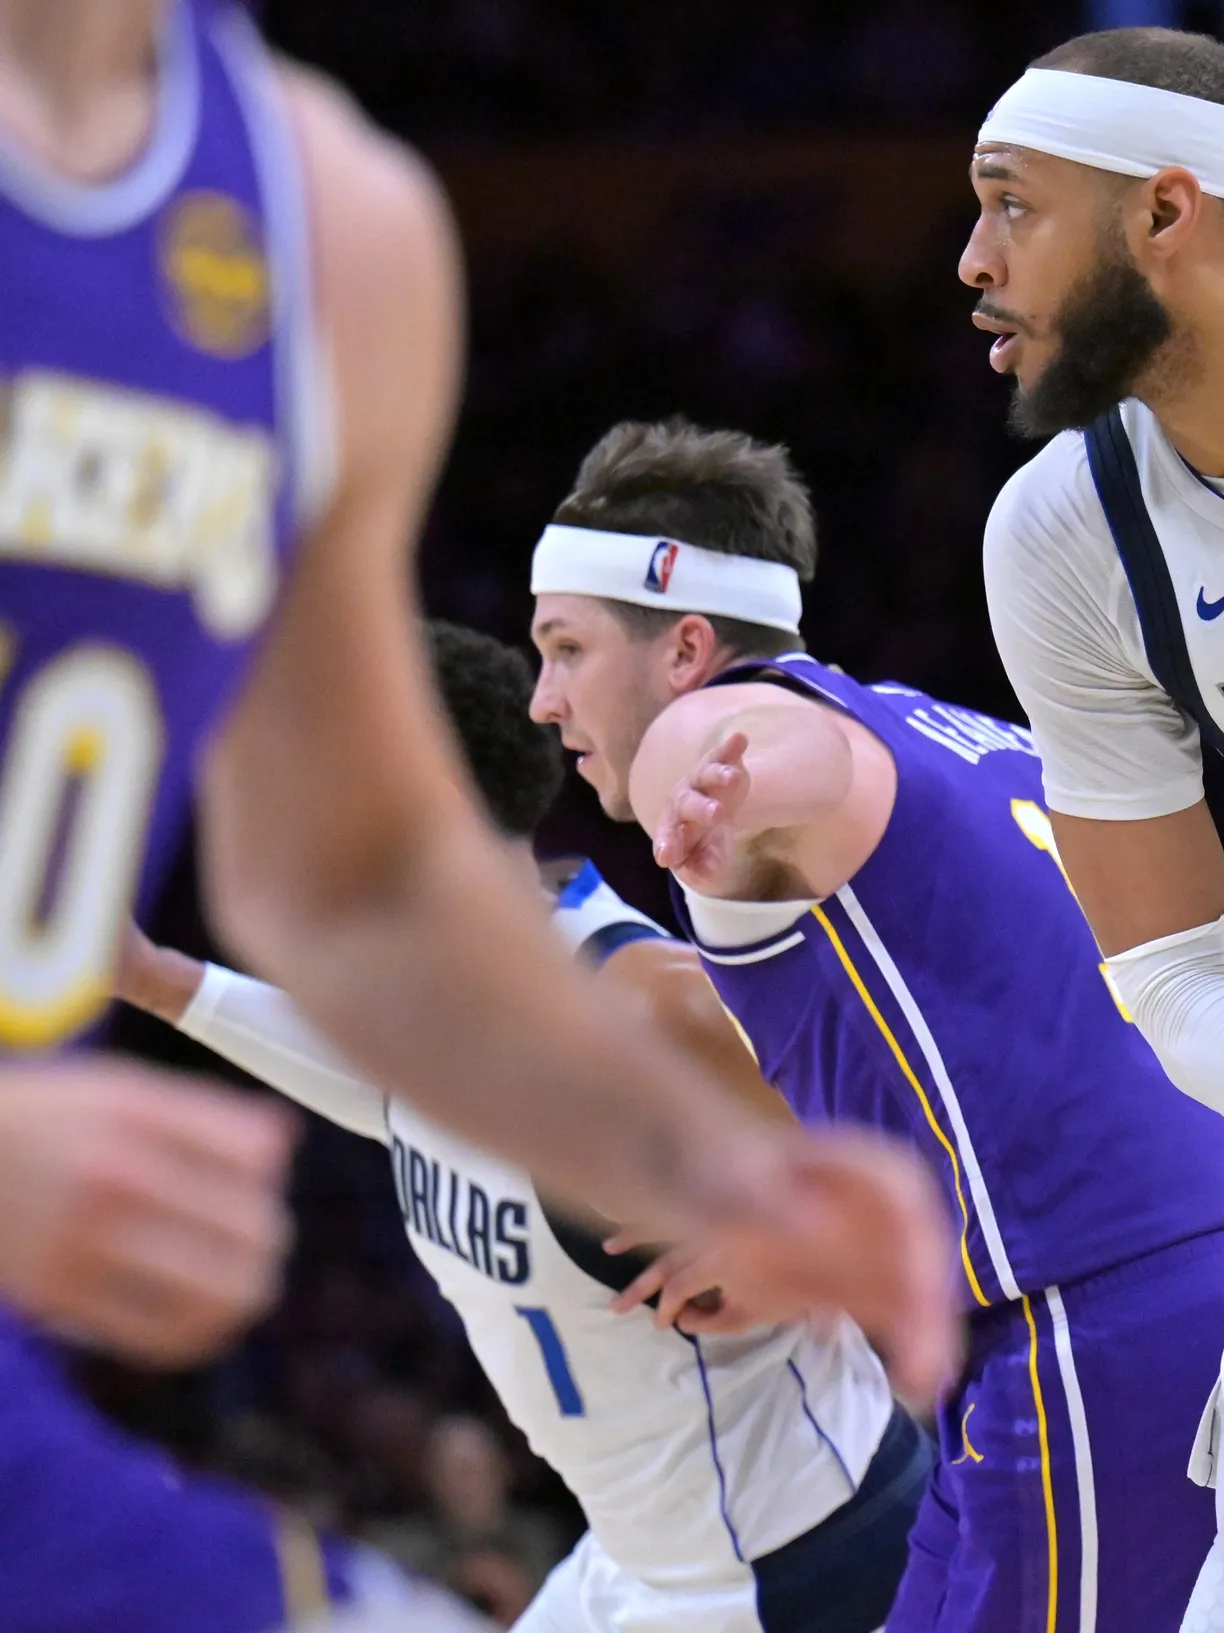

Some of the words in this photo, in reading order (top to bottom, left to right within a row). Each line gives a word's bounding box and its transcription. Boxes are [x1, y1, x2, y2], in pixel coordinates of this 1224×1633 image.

[0, 641, 165, 1050] 0
[392, 1133, 531, 1286] DALLAS
[513, 1304, 587, 1418] 1
